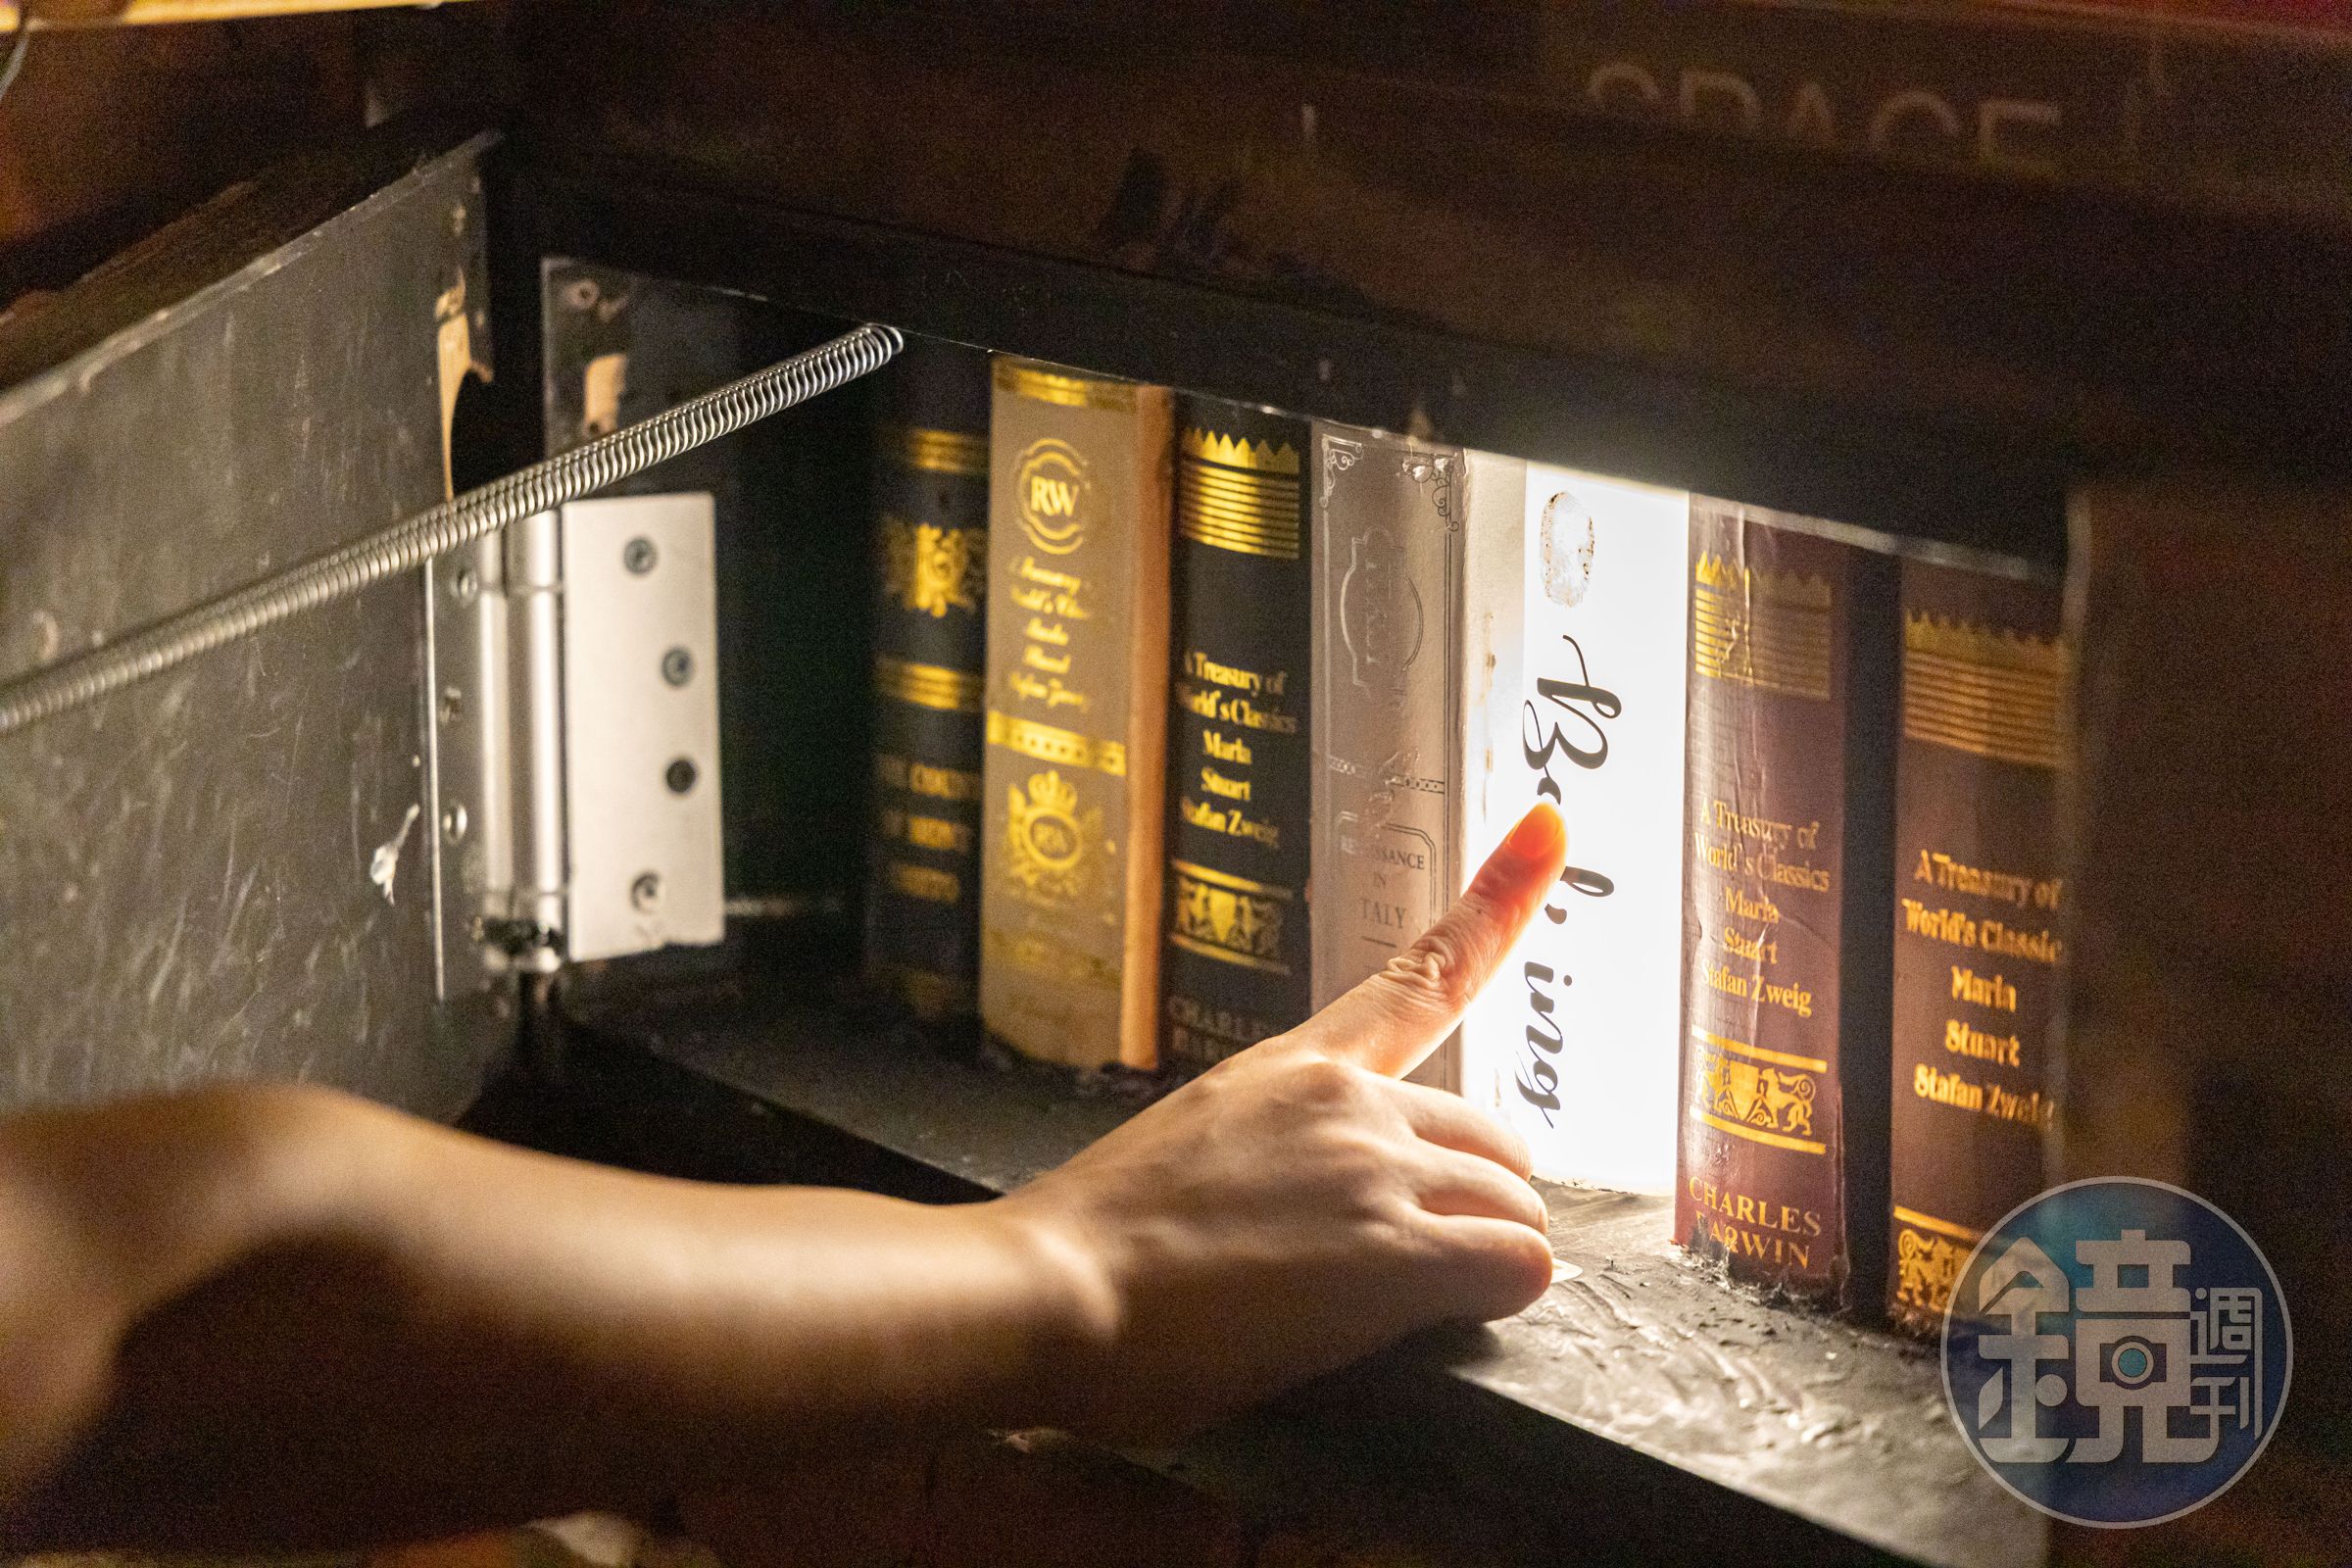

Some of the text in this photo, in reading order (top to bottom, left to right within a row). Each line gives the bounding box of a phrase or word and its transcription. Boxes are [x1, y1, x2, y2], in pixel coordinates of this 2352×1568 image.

[1357, 896, 1408, 930] TALY
[1751, 974, 1812, 1018] Zweig
[1944, 1018, 2021, 1068] Stuart
[1689, 1175, 1822, 1238] CHARLES
[1695, 1209, 1810, 1271] ARWIN
